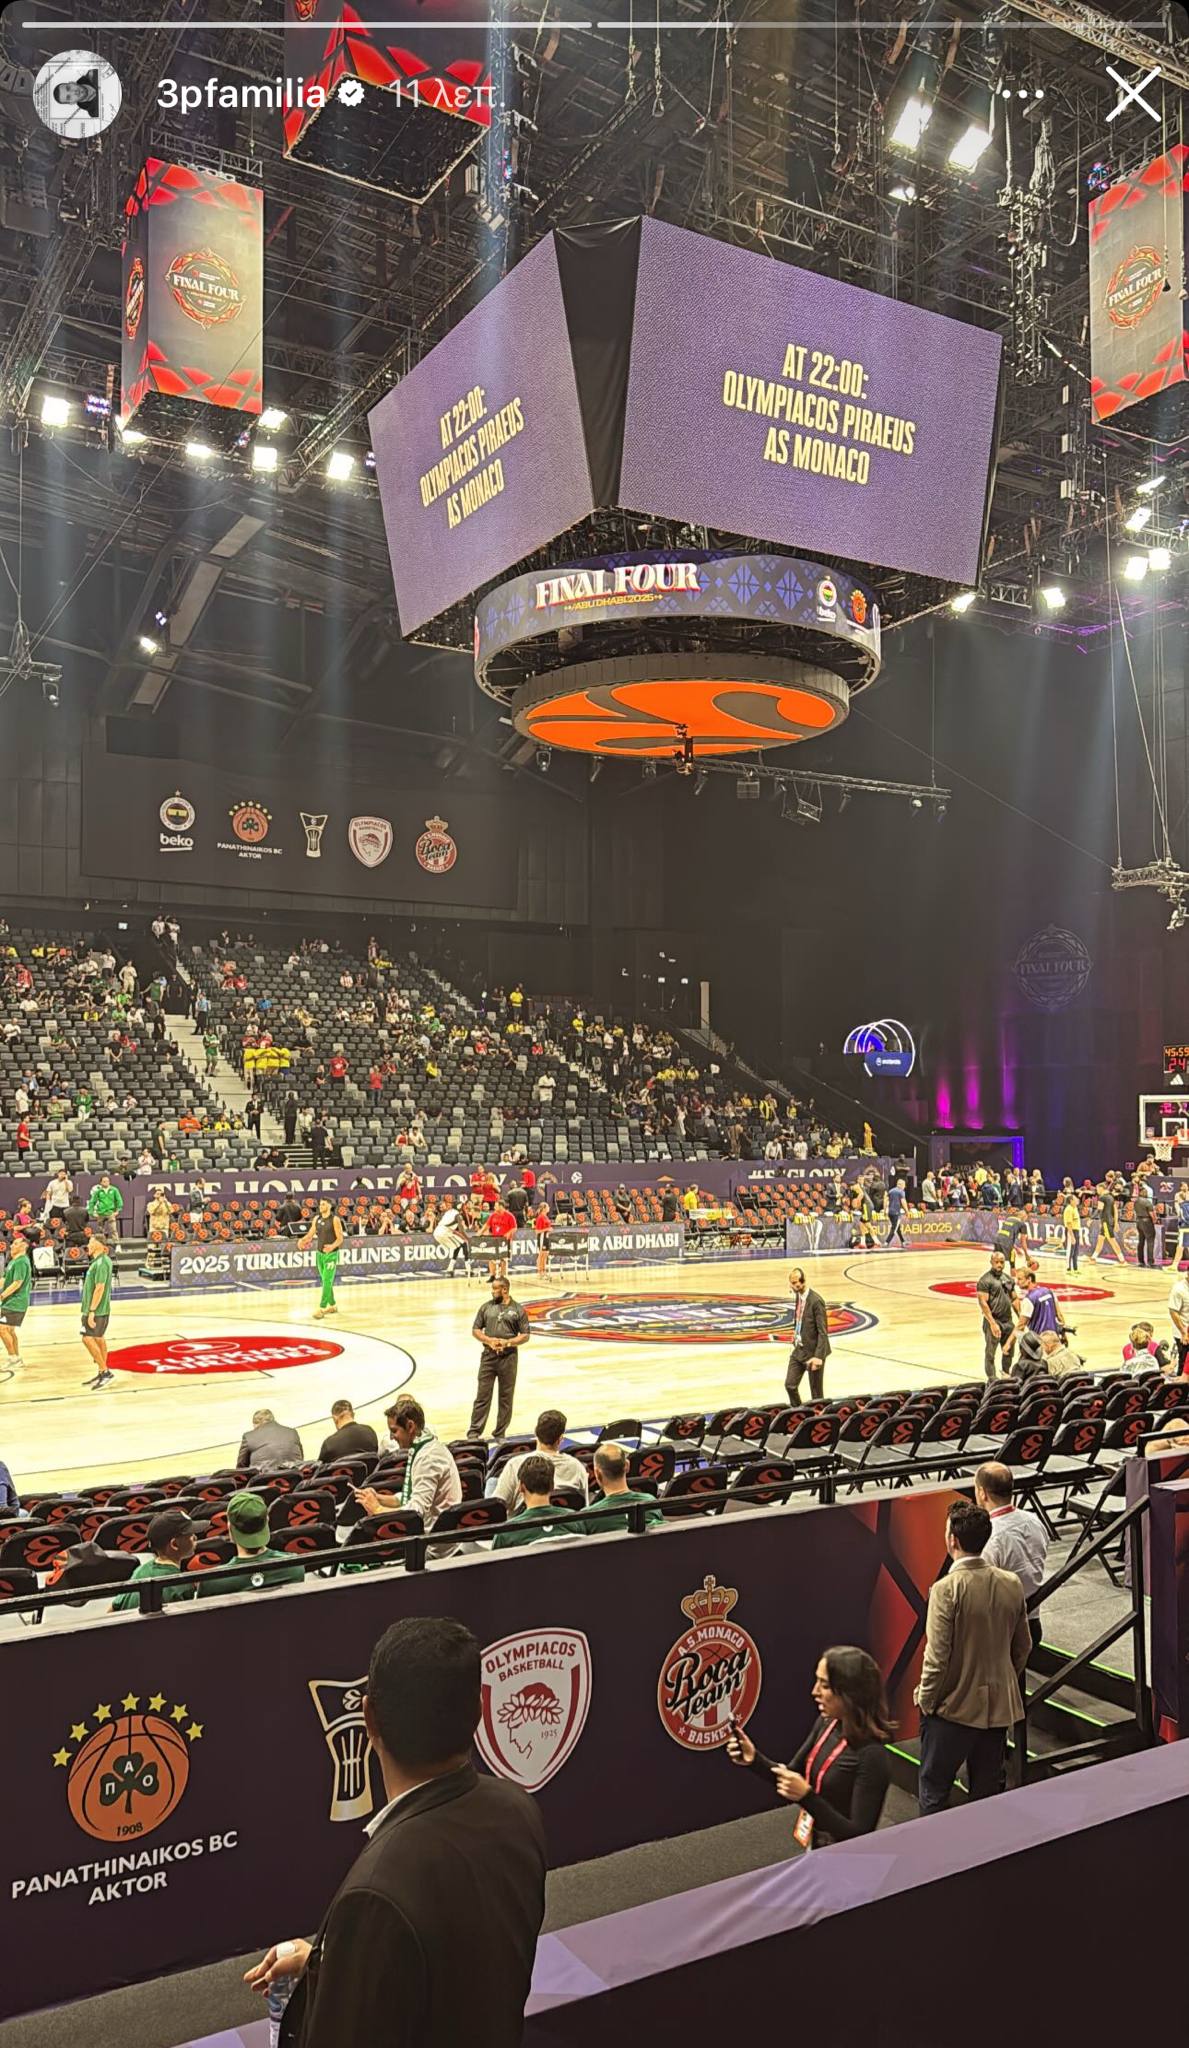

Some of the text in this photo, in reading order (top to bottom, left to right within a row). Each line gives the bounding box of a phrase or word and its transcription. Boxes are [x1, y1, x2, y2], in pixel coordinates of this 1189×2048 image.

[173, 274, 207, 293] FINAL
[208, 285, 239, 301] FOUR
[1108, 286, 1135, 307] FINAL
[1135, 268, 1162, 291] FOUR
[782, 343, 869, 400] AT 22:00:
[440, 385, 488, 450] AT 22:00:
[723, 370, 916, 454] OLYMPIACOS PIRAEUS
[420, 397, 525, 507] OLYMPIACOS PIRAEUS
[763, 426, 870, 485] AS MONACO
[447, 458, 505, 529] AS MONACO
[536, 563, 701, 609] FINAL FOUR
[160, 833, 194, 847] beko
[217, 843, 272, 854] PANATHINAIKOS
[602, 1235, 634, 1250] ABU
[635, 1232, 680, 1249] DHABI
[924, 1222, 953, 1233] 2025
[179, 1255, 231, 1274] 2025
[234, 1250, 317, 1272] TURKISH
[138, 1345, 314, 1366] TURKISH
[155, 1348, 332, 1372] AIRLINES
[485, 1641, 577, 1674] OLYMPIACOS
[498, 1658, 565, 1682] BASKETBALL
[665, 1648, 751, 1709] Roca
[671, 1671, 742, 1723] Team
[540, 1729, 559, 1740] 1925
[116, 1822, 144, 1837] 1908
[11, 1831, 238, 1899] PANATHINAIKOS BC
[88, 1871, 168, 1905] AKTOR
